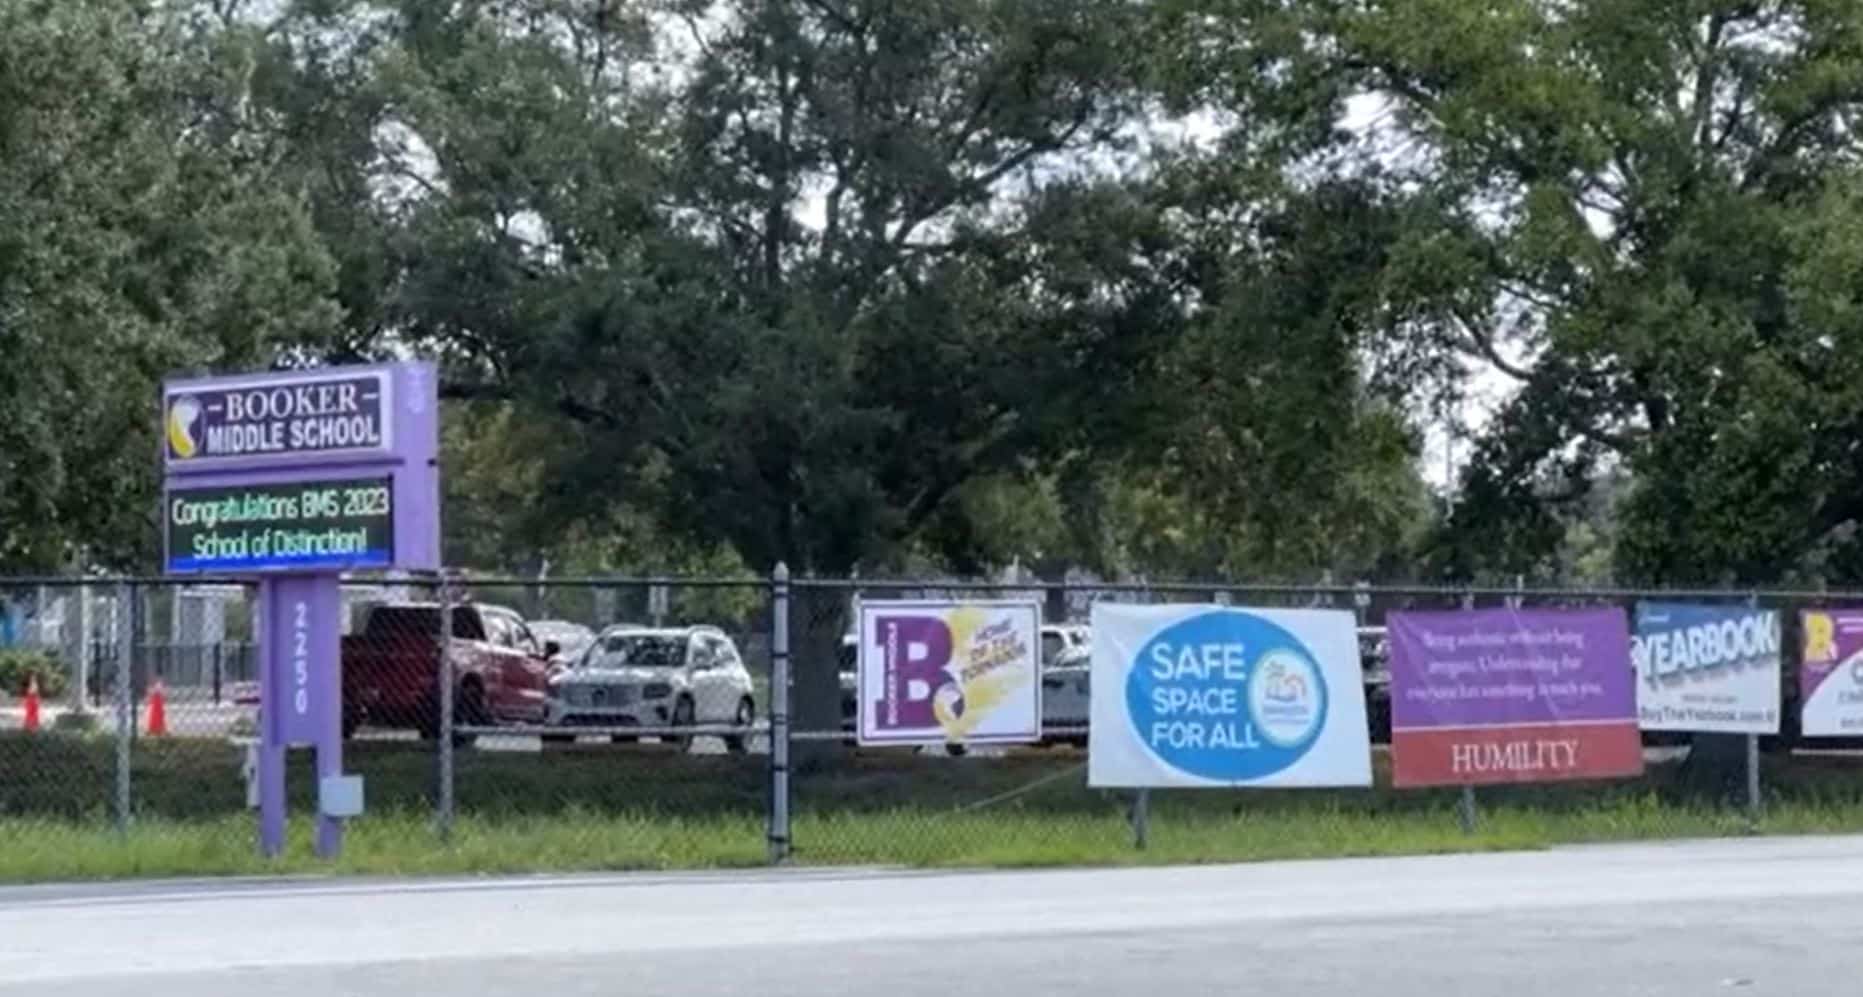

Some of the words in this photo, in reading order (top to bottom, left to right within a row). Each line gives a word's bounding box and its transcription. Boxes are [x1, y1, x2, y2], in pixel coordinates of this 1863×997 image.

[207, 422, 285, 453] MIDDLE
[290, 416, 378, 448] SCHOOL
[172, 493, 298, 528] Congratulations
[302, 491, 340, 518] BMS
[344, 487, 390, 515] 2023
[192, 530, 248, 560] School
[251, 529, 271, 557] of
[1151, 643, 1246, 680] SAFE
[1634, 612, 1777, 678] YEARBOOK
[1152, 687, 1237, 714] SPACE
[1151, 722, 1204, 748] FOR
[1209, 723, 1260, 748] ALL
[1452, 740, 1578, 773] HUMILITY
